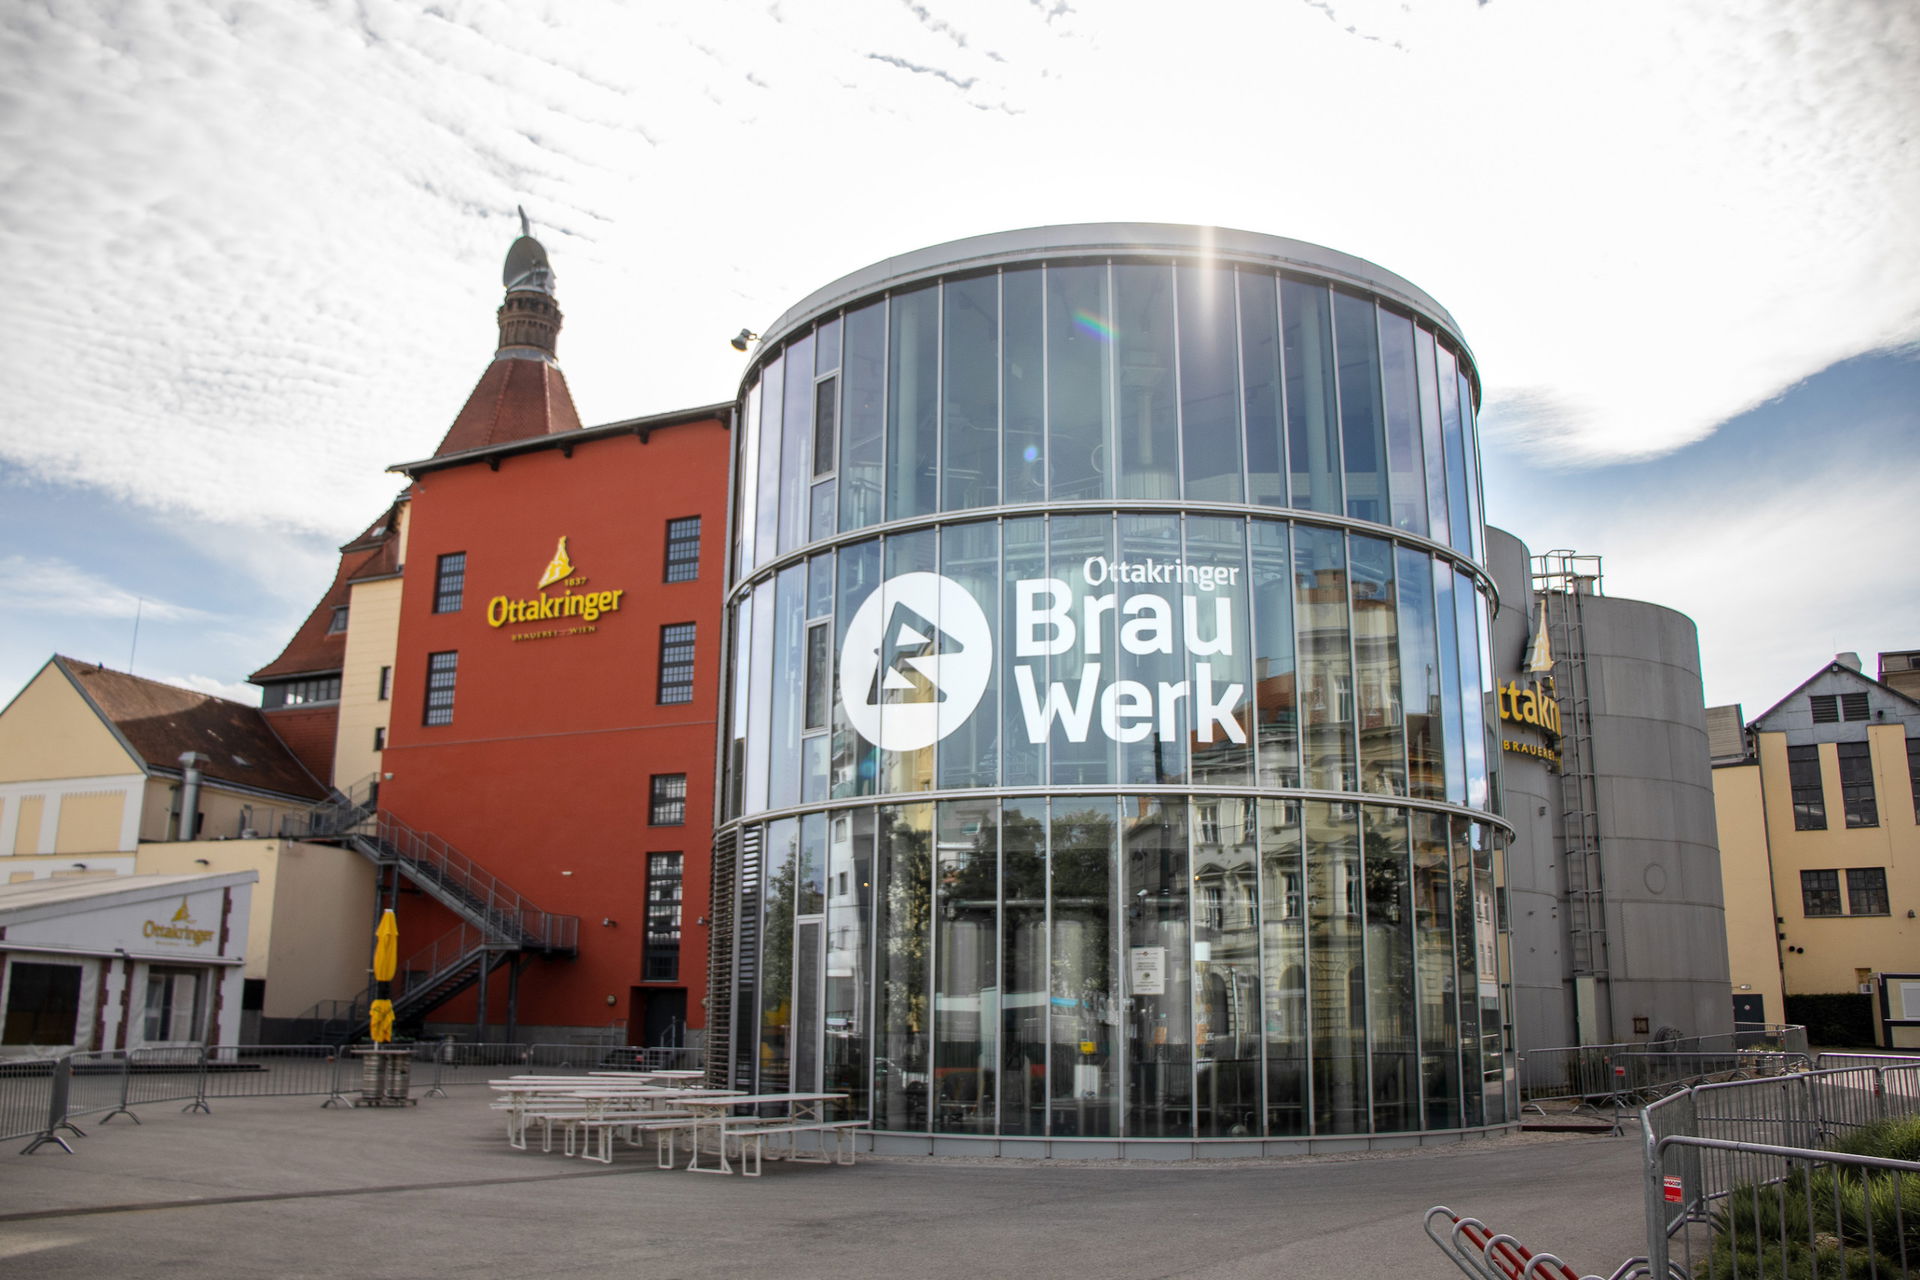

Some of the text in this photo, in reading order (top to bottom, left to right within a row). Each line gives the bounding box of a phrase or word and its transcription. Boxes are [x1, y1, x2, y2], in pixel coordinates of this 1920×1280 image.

[564, 577, 587, 587] 1837
[1083, 556, 1240, 591] Ottakringer
[487, 589, 624, 628] Ottakringer
[1015, 578, 1233, 657] Brau
[1014, 662, 1247, 744] Werk
[143, 919, 215, 945] Ottakringer
